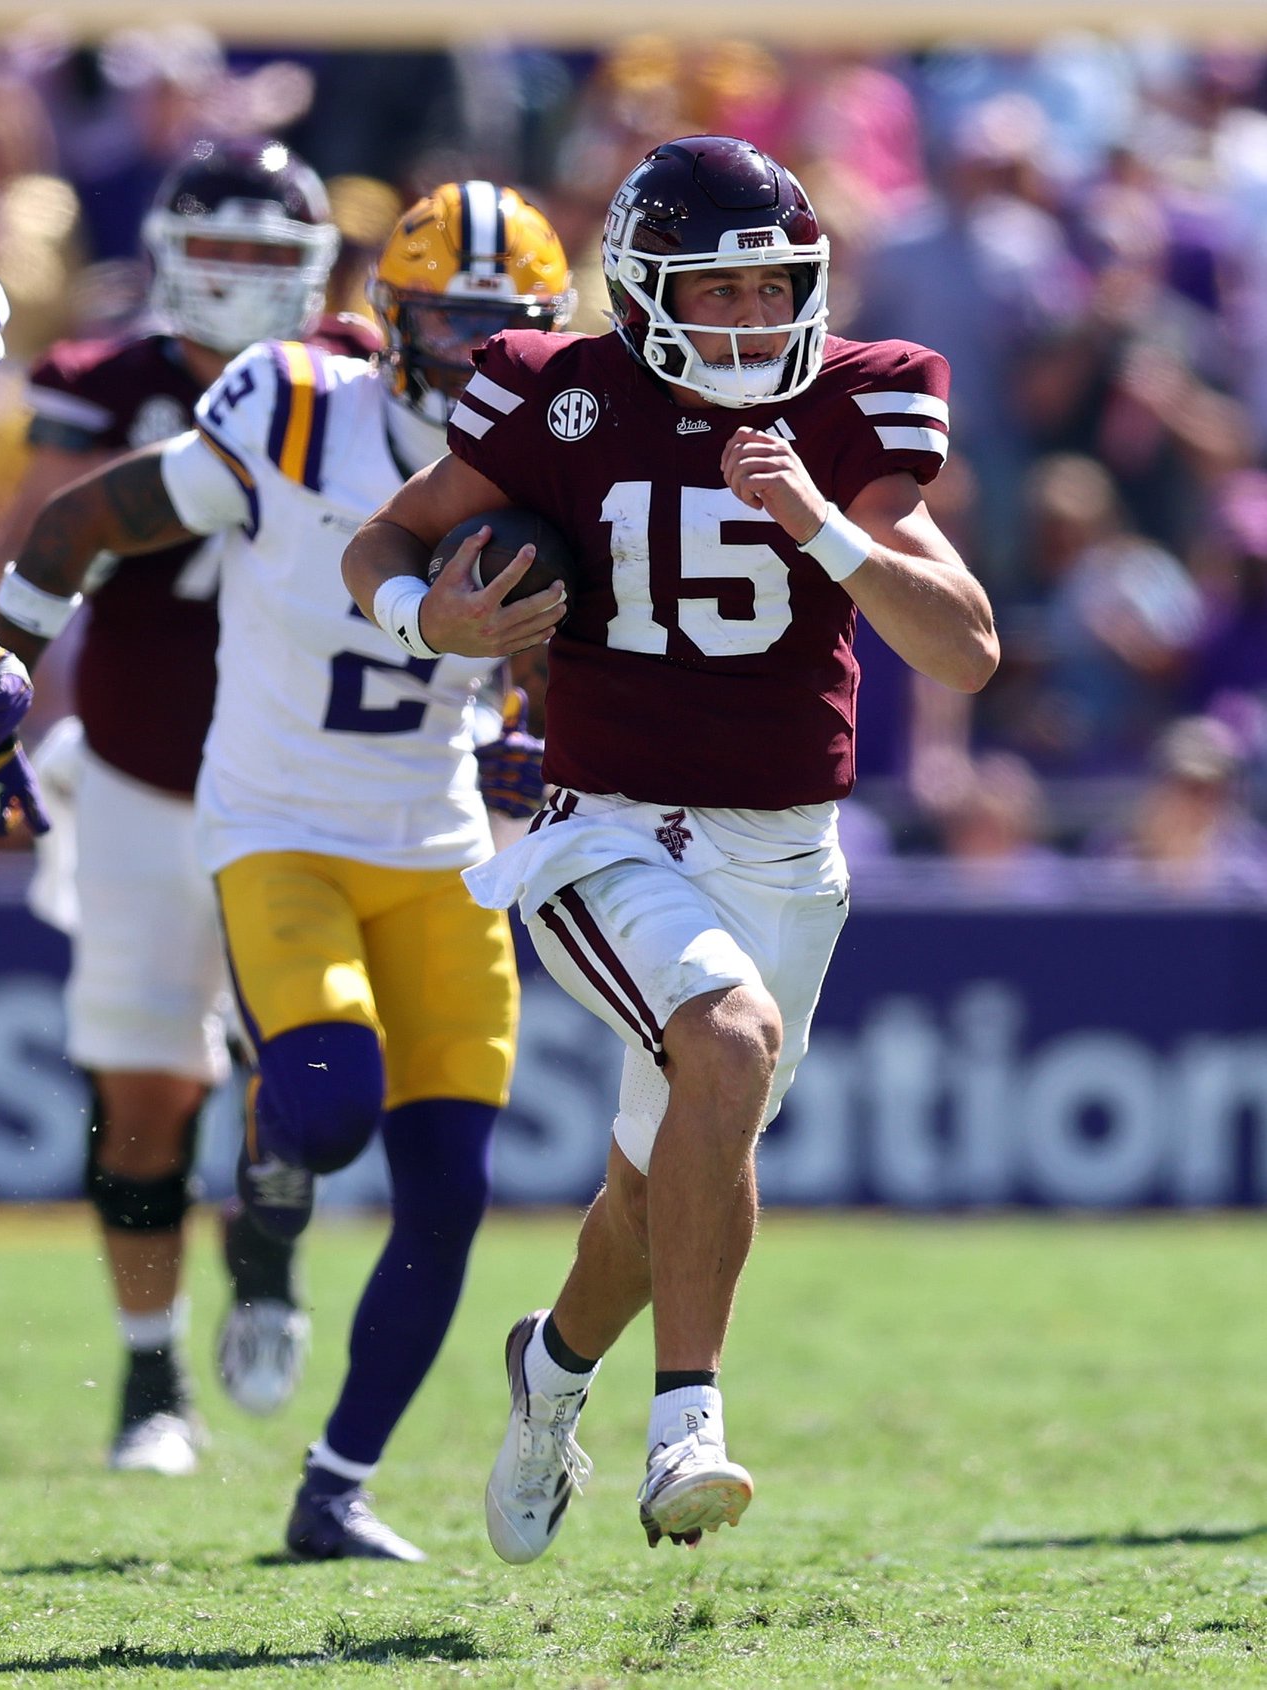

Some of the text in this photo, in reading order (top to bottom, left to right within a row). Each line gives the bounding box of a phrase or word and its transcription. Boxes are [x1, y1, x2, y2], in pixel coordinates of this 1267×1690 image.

[737, 236, 774, 249] STATE
[552, 392, 593, 437] SEC
[676, 416, 710, 433] State
[598, 481, 793, 657] 15
[494, 978, 1267, 1208] Sation
